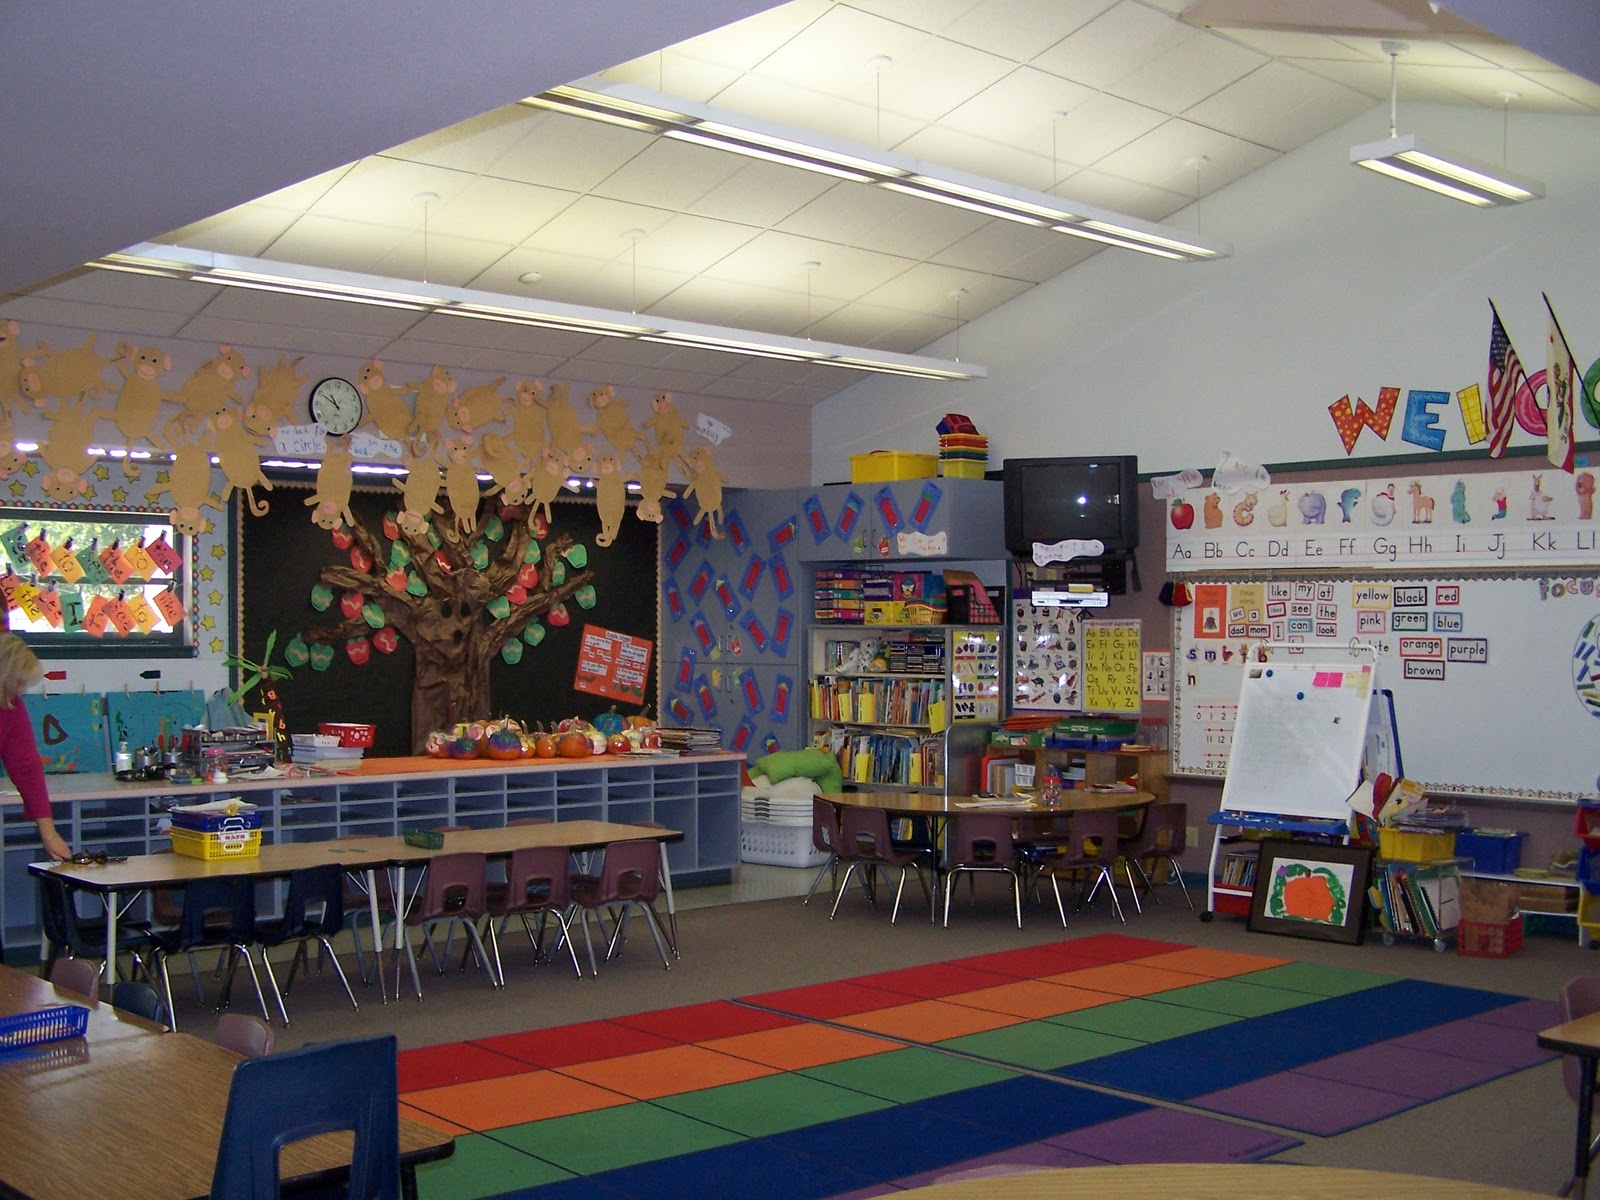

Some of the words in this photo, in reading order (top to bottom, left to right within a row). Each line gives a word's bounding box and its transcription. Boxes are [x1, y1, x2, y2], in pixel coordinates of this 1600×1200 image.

[1172, 544, 1192, 559] Aa
[1204, 542, 1223, 558] Bb
[1235, 541, 1255, 558] Cc
[1268, 540, 1289, 557] Dd
[1305, 539, 1323, 556] Ee
[1339, 538, 1356, 556] Ff
[1373, 537, 1397, 562] Gg
[1409, 536, 1433, 553] Hh
[1455, 534, 1466, 552] Ii
[1487, 533, 1506, 559] Jj
[1532, 532, 1556, 551] Kk
[1577, 531, 1595, 550] Ll
[1271, 585, 1288, 597] like
[1298, 584, 1312, 597] my
[1320, 586, 1331, 598] at
[1356, 588, 1389, 604] yellow
[1396, 591, 1424, 603] black
[1438, 590, 1457, 601] red
[1251, 611, 1257, 619] a
[1292, 605, 1309, 613] see
[1319, 606, 1336, 618] the
[1230, 626, 1245, 635] dad
[1250, 626, 1267, 634] mom
[1276, 625, 1281, 637] I
[1291, 620, 1308, 630] can
[1318, 626, 1335, 635] look
[1360, 613, 1381, 629] pink
[1394, 615, 1425, 627] green
[1437, 615, 1459, 629] blue
[1402, 641, 1440, 654] orange
[1450, 642, 1485, 659] purple
[1407, 662, 1441, 676] brown
[1221, 712, 1226, 720] 2
